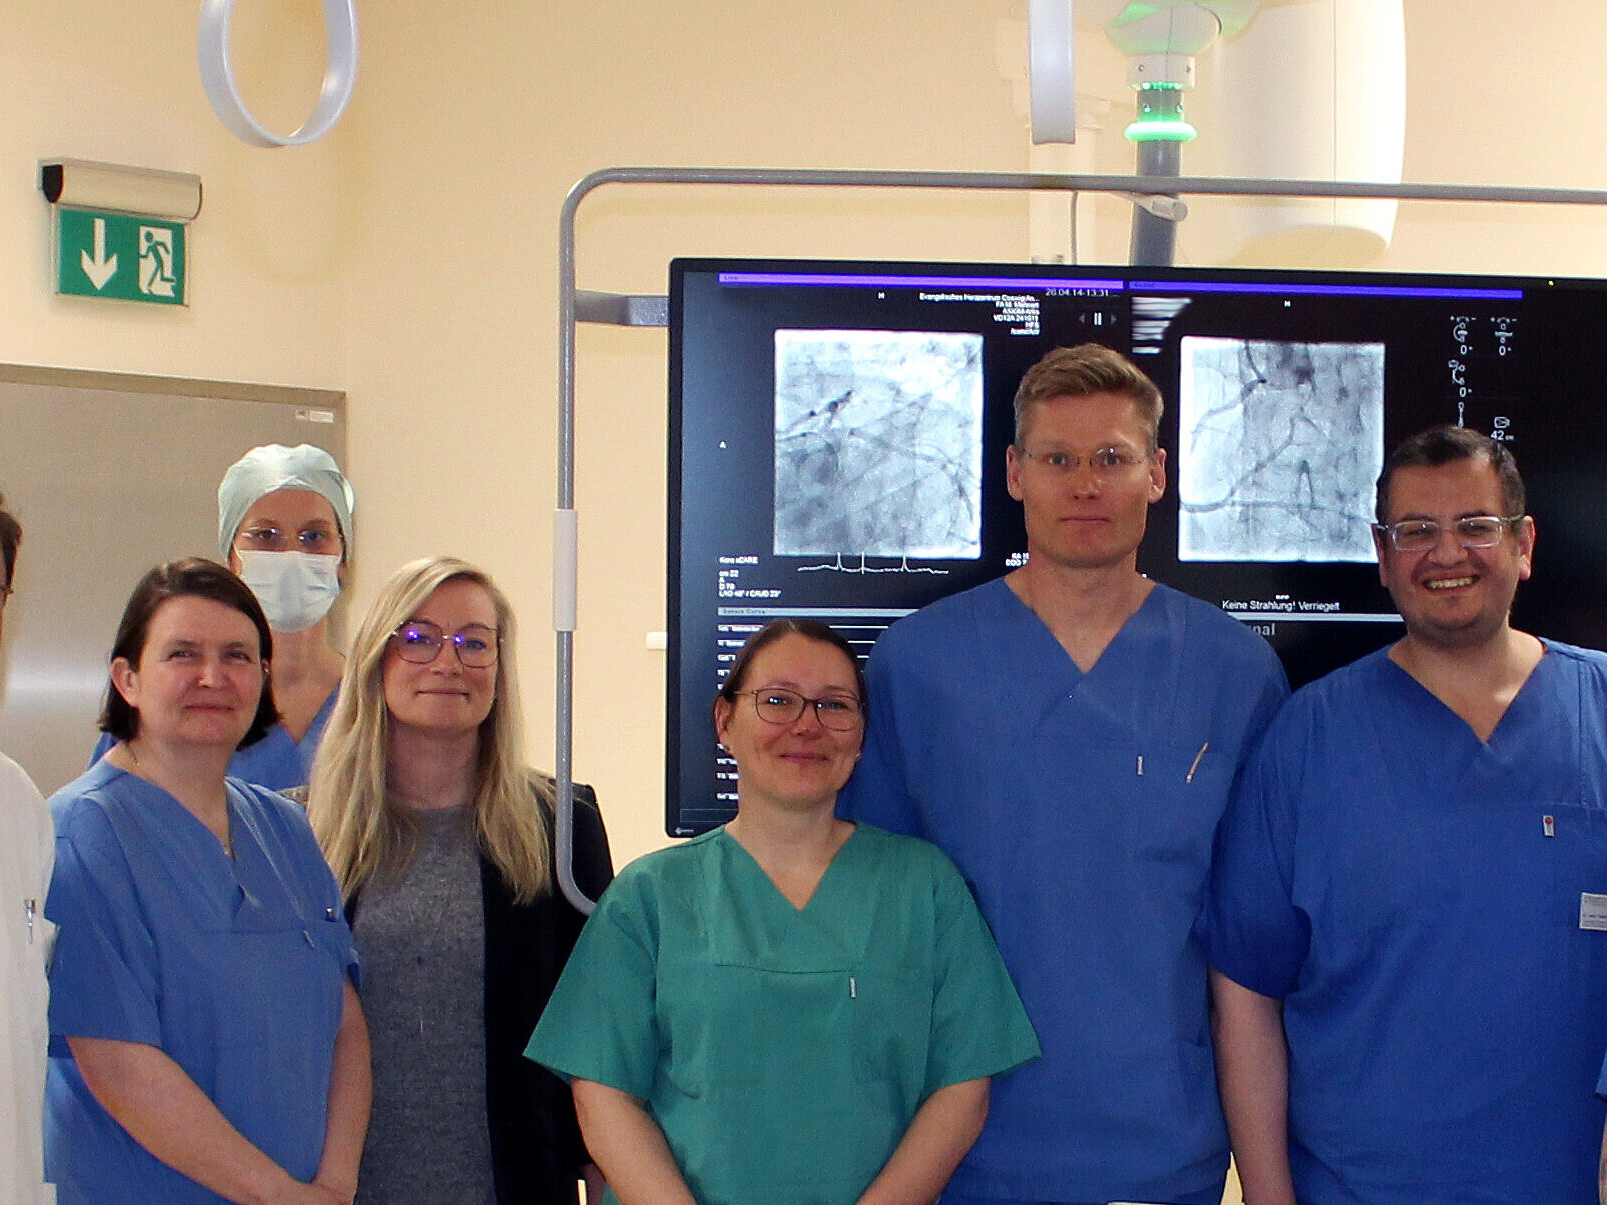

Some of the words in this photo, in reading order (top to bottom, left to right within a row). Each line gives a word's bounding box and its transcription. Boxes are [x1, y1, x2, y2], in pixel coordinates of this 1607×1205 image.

[1491, 430, 1505, 441] 42
[1222, 600, 1248, 610] Keine
[1250, 600, 1296, 613] Strahlung!
[1298, 601, 1340, 613] Verriegelt
